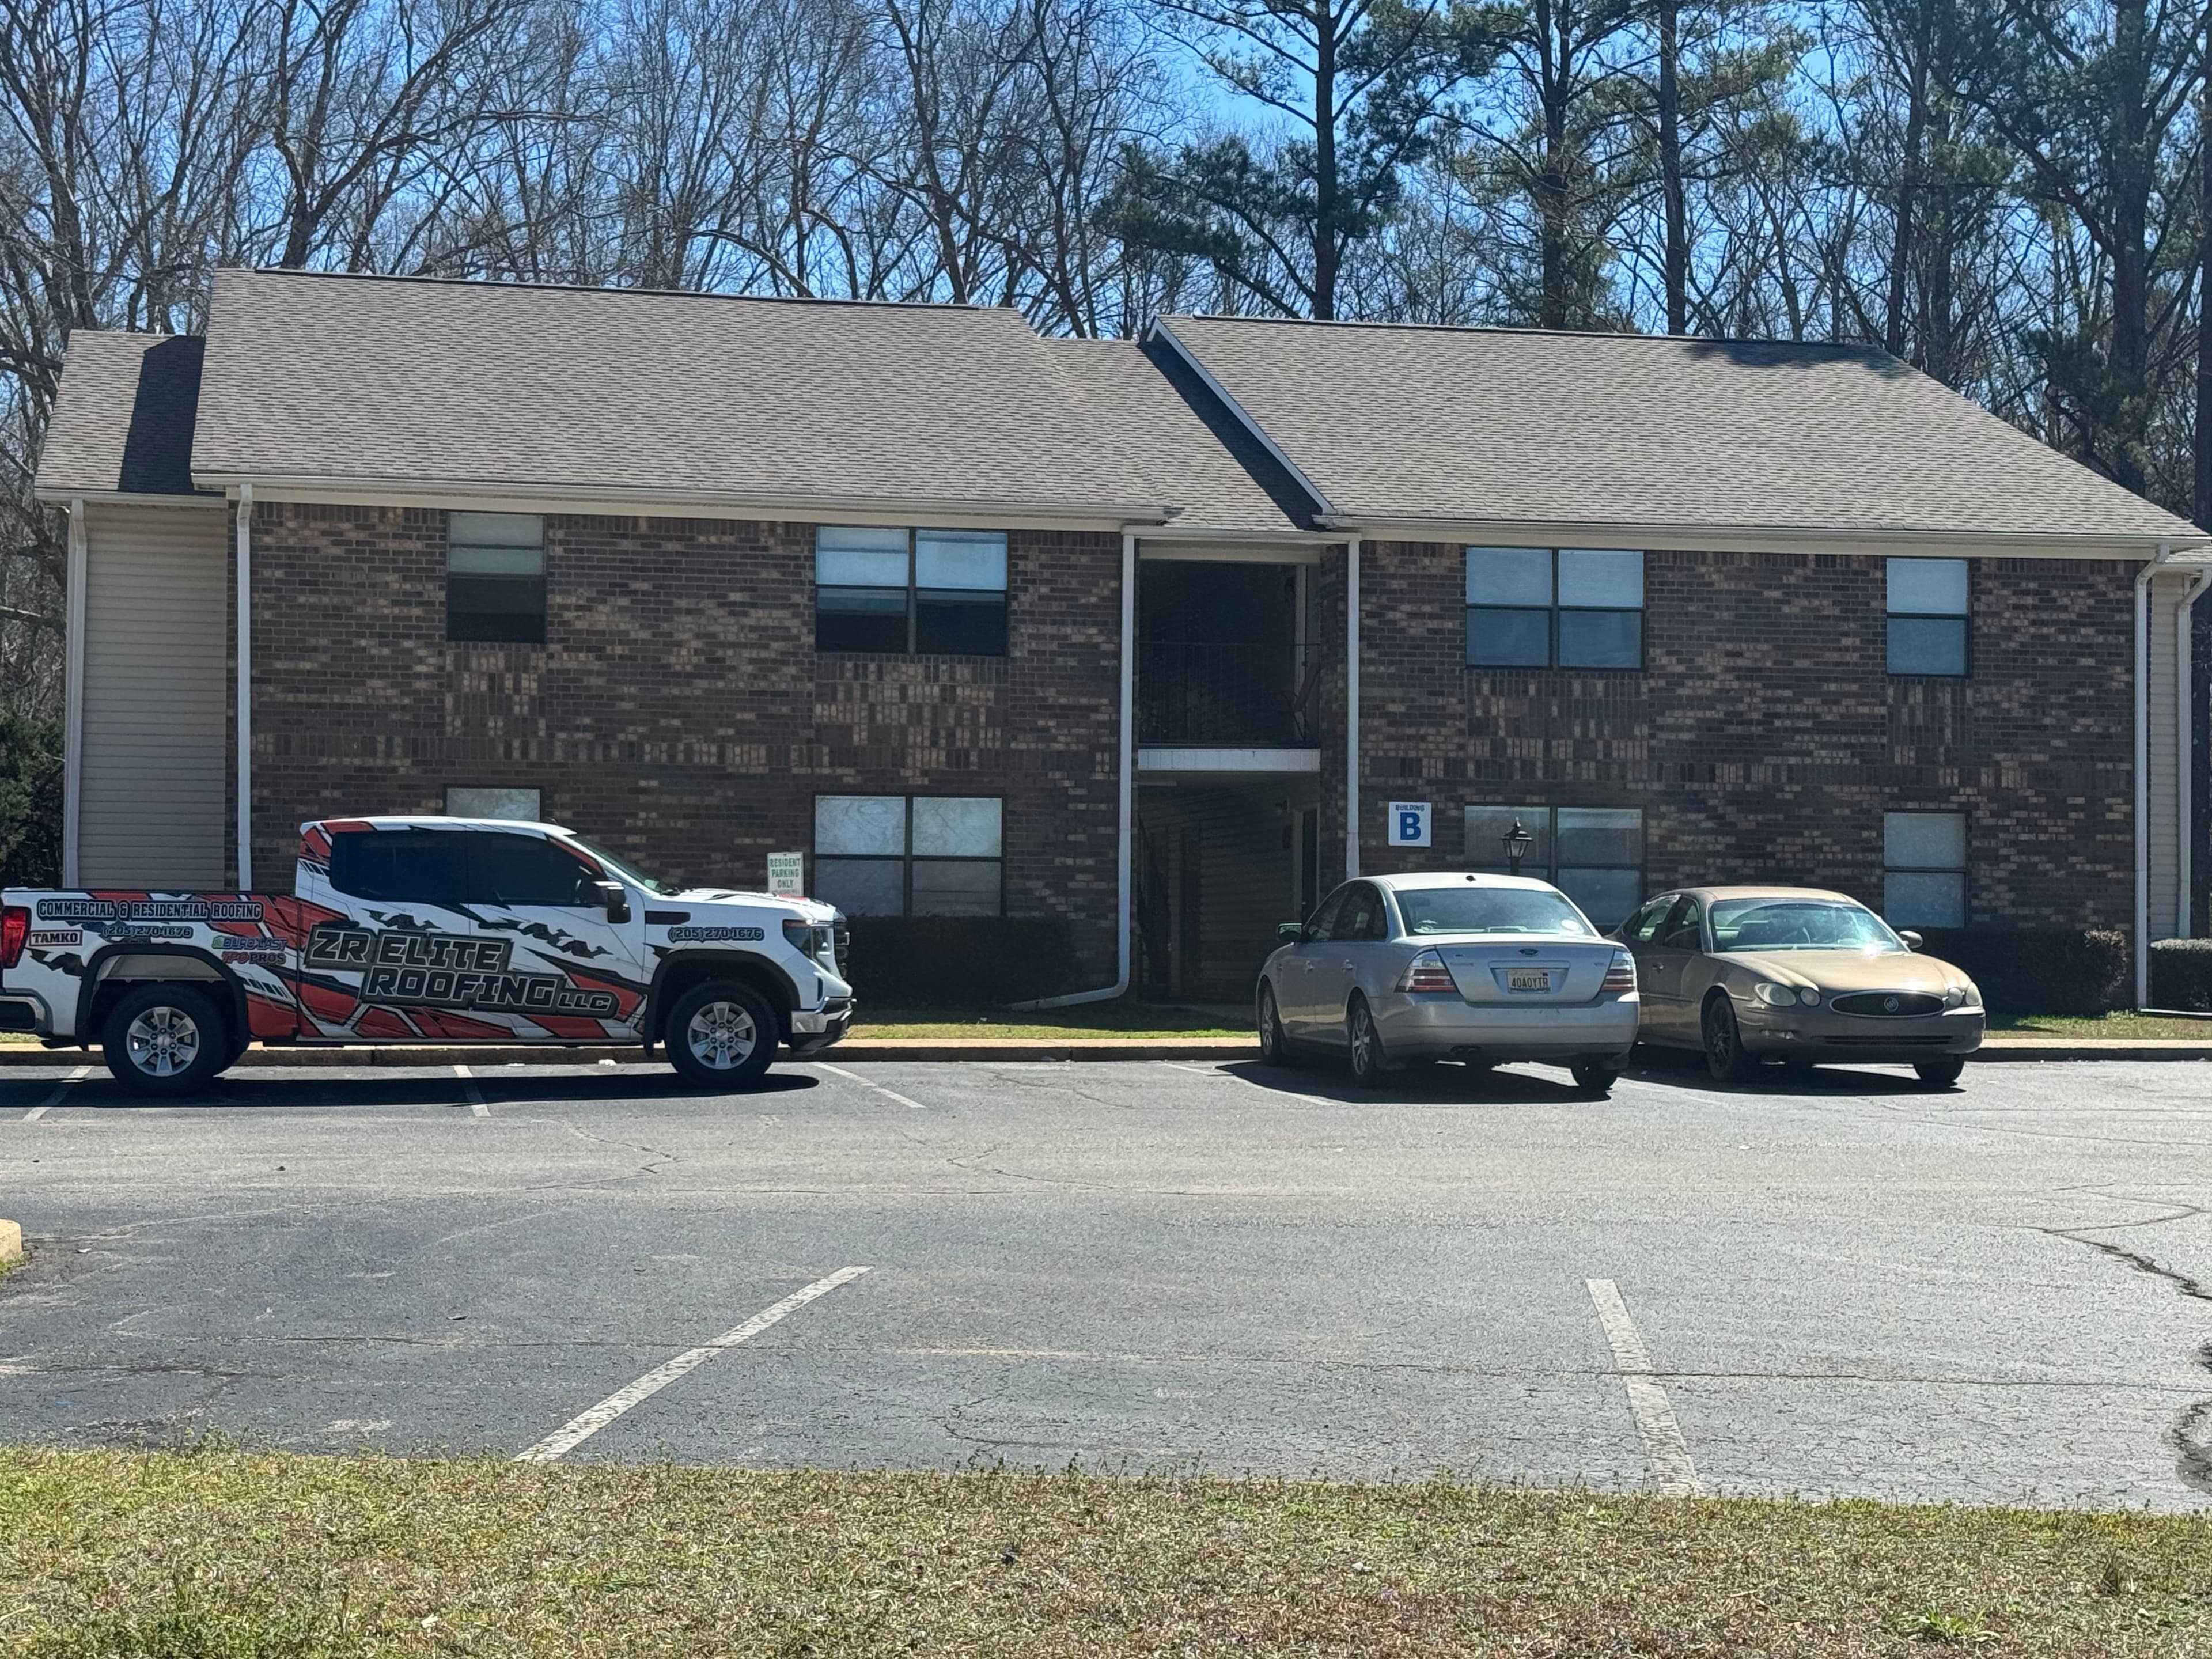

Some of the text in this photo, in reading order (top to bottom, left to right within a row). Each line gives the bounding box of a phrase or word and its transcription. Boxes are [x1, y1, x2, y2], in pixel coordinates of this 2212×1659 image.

[1400, 812, 1421, 840] B
[770, 858, 801, 868] RESIDENT
[771, 868, 799, 878] PARKING
[778, 879, 794, 888] ONLY
[38, 900, 262, 920] COMMERCIAL & RESIDENTIAL ROOFING
[32, 932, 78, 944] TAMKO
[310, 929, 505, 972] ZR ELITE
[249, 952, 286, 964] PROS
[365, 965, 612, 1012] ROOFING LLC
